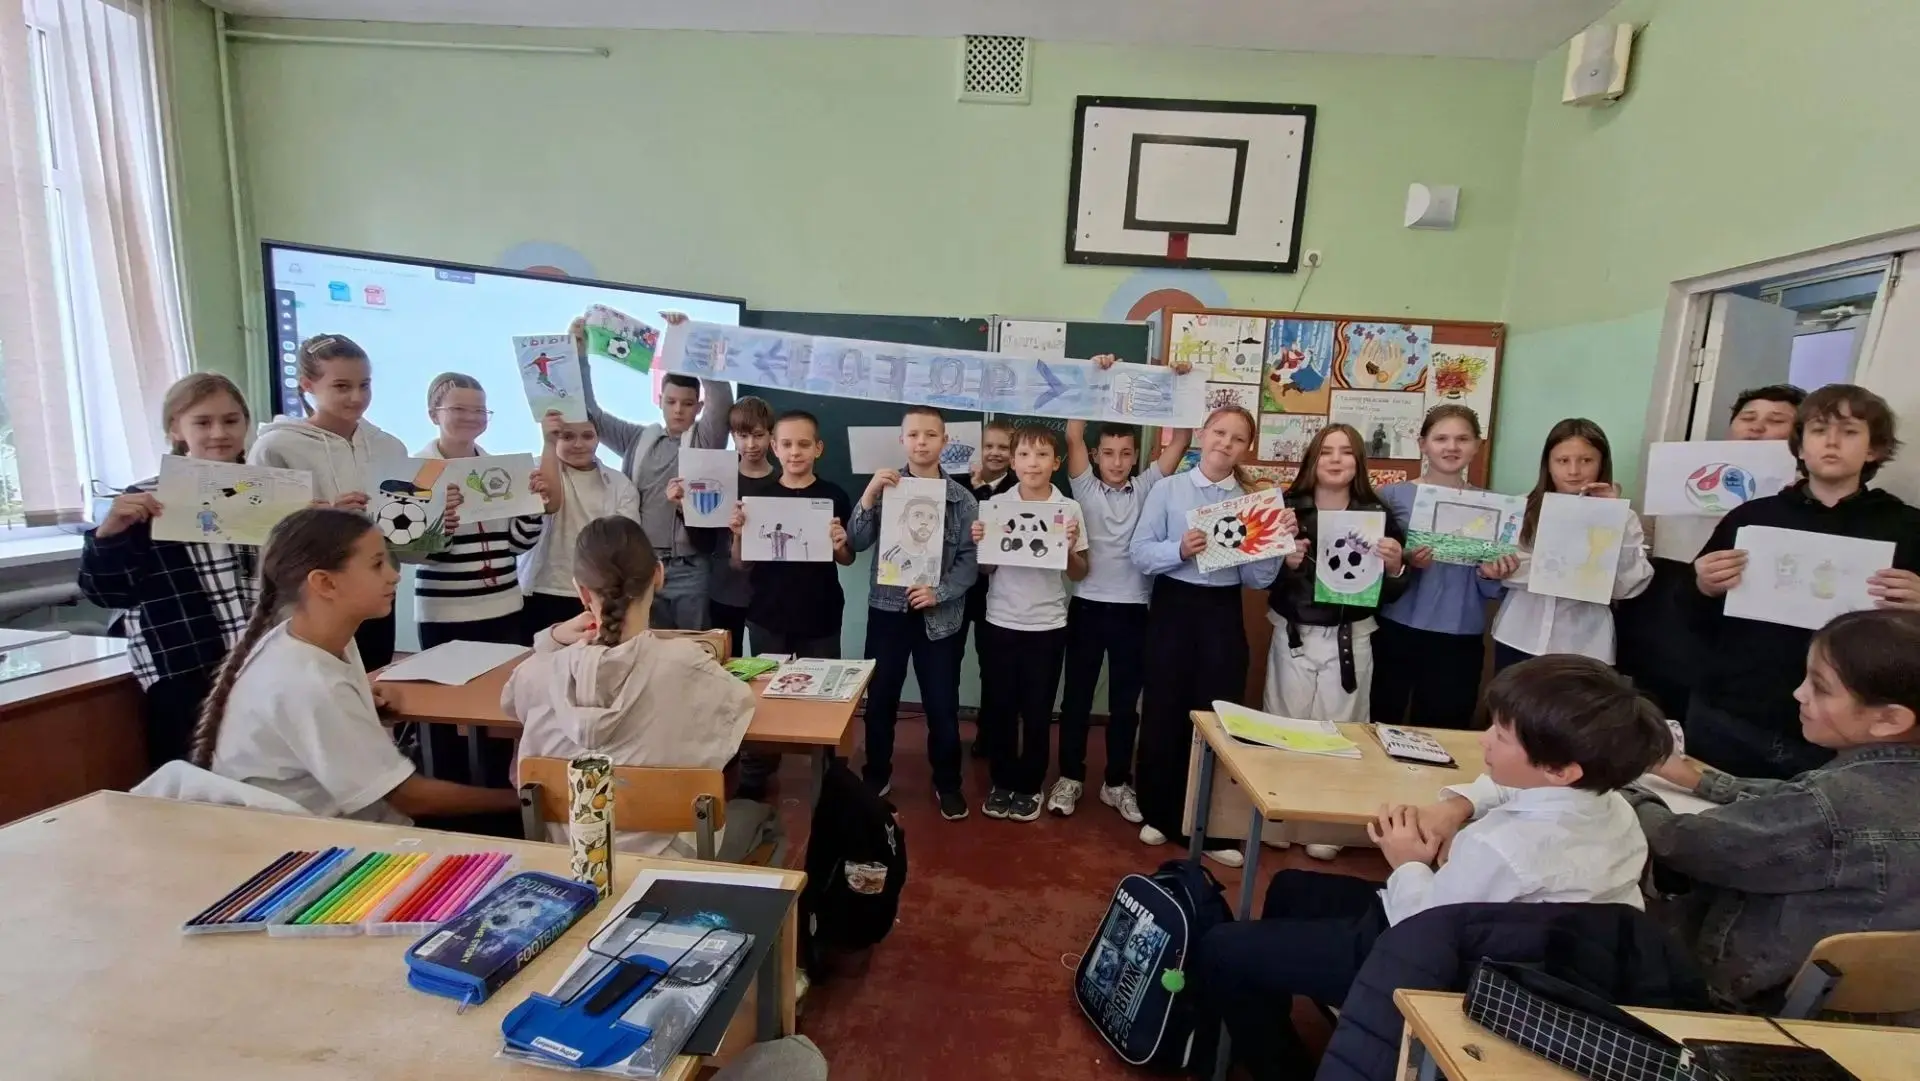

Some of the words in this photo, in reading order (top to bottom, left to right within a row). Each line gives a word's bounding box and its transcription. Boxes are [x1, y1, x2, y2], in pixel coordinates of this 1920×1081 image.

[1116, 888, 1155, 923] SCOOTER
[1114, 963, 1142, 1013] BMX
[1103, 1002, 1132, 1039] SPORTS
